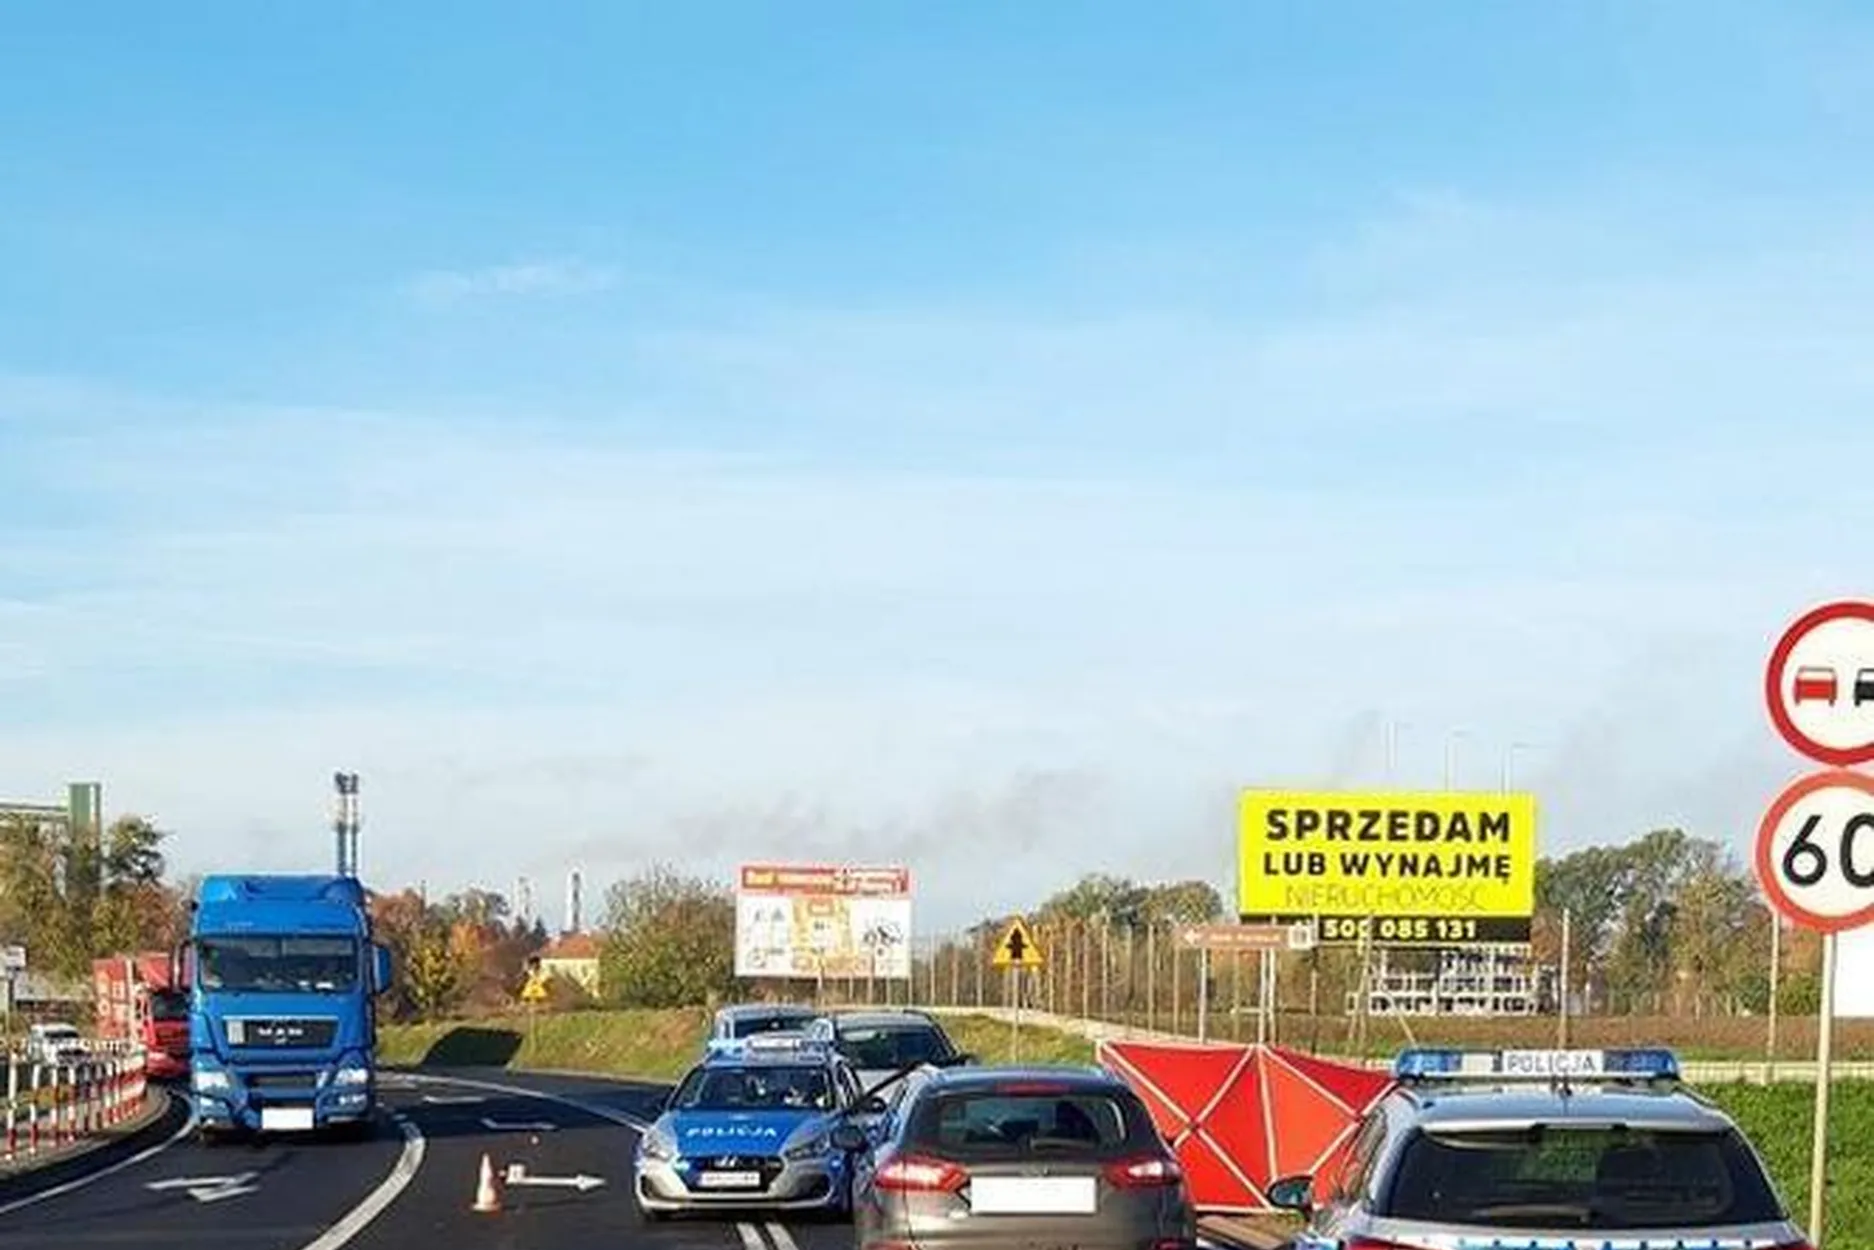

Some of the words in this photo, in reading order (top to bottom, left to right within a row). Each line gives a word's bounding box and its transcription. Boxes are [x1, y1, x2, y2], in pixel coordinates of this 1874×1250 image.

[1265, 808, 1511, 843] SPRZEDAM
[1781, 812, 1874, 888] 60
[1263, 852, 1327, 876] LUB
[1339, 852, 1512, 885] WYNAJMĘ
[1379, 918, 1429, 939] 085
[1436, 918, 1477, 940] 131
[1506, 1053, 1597, 1074] POLICJA
[685, 1126, 778, 1138] POLICJA
